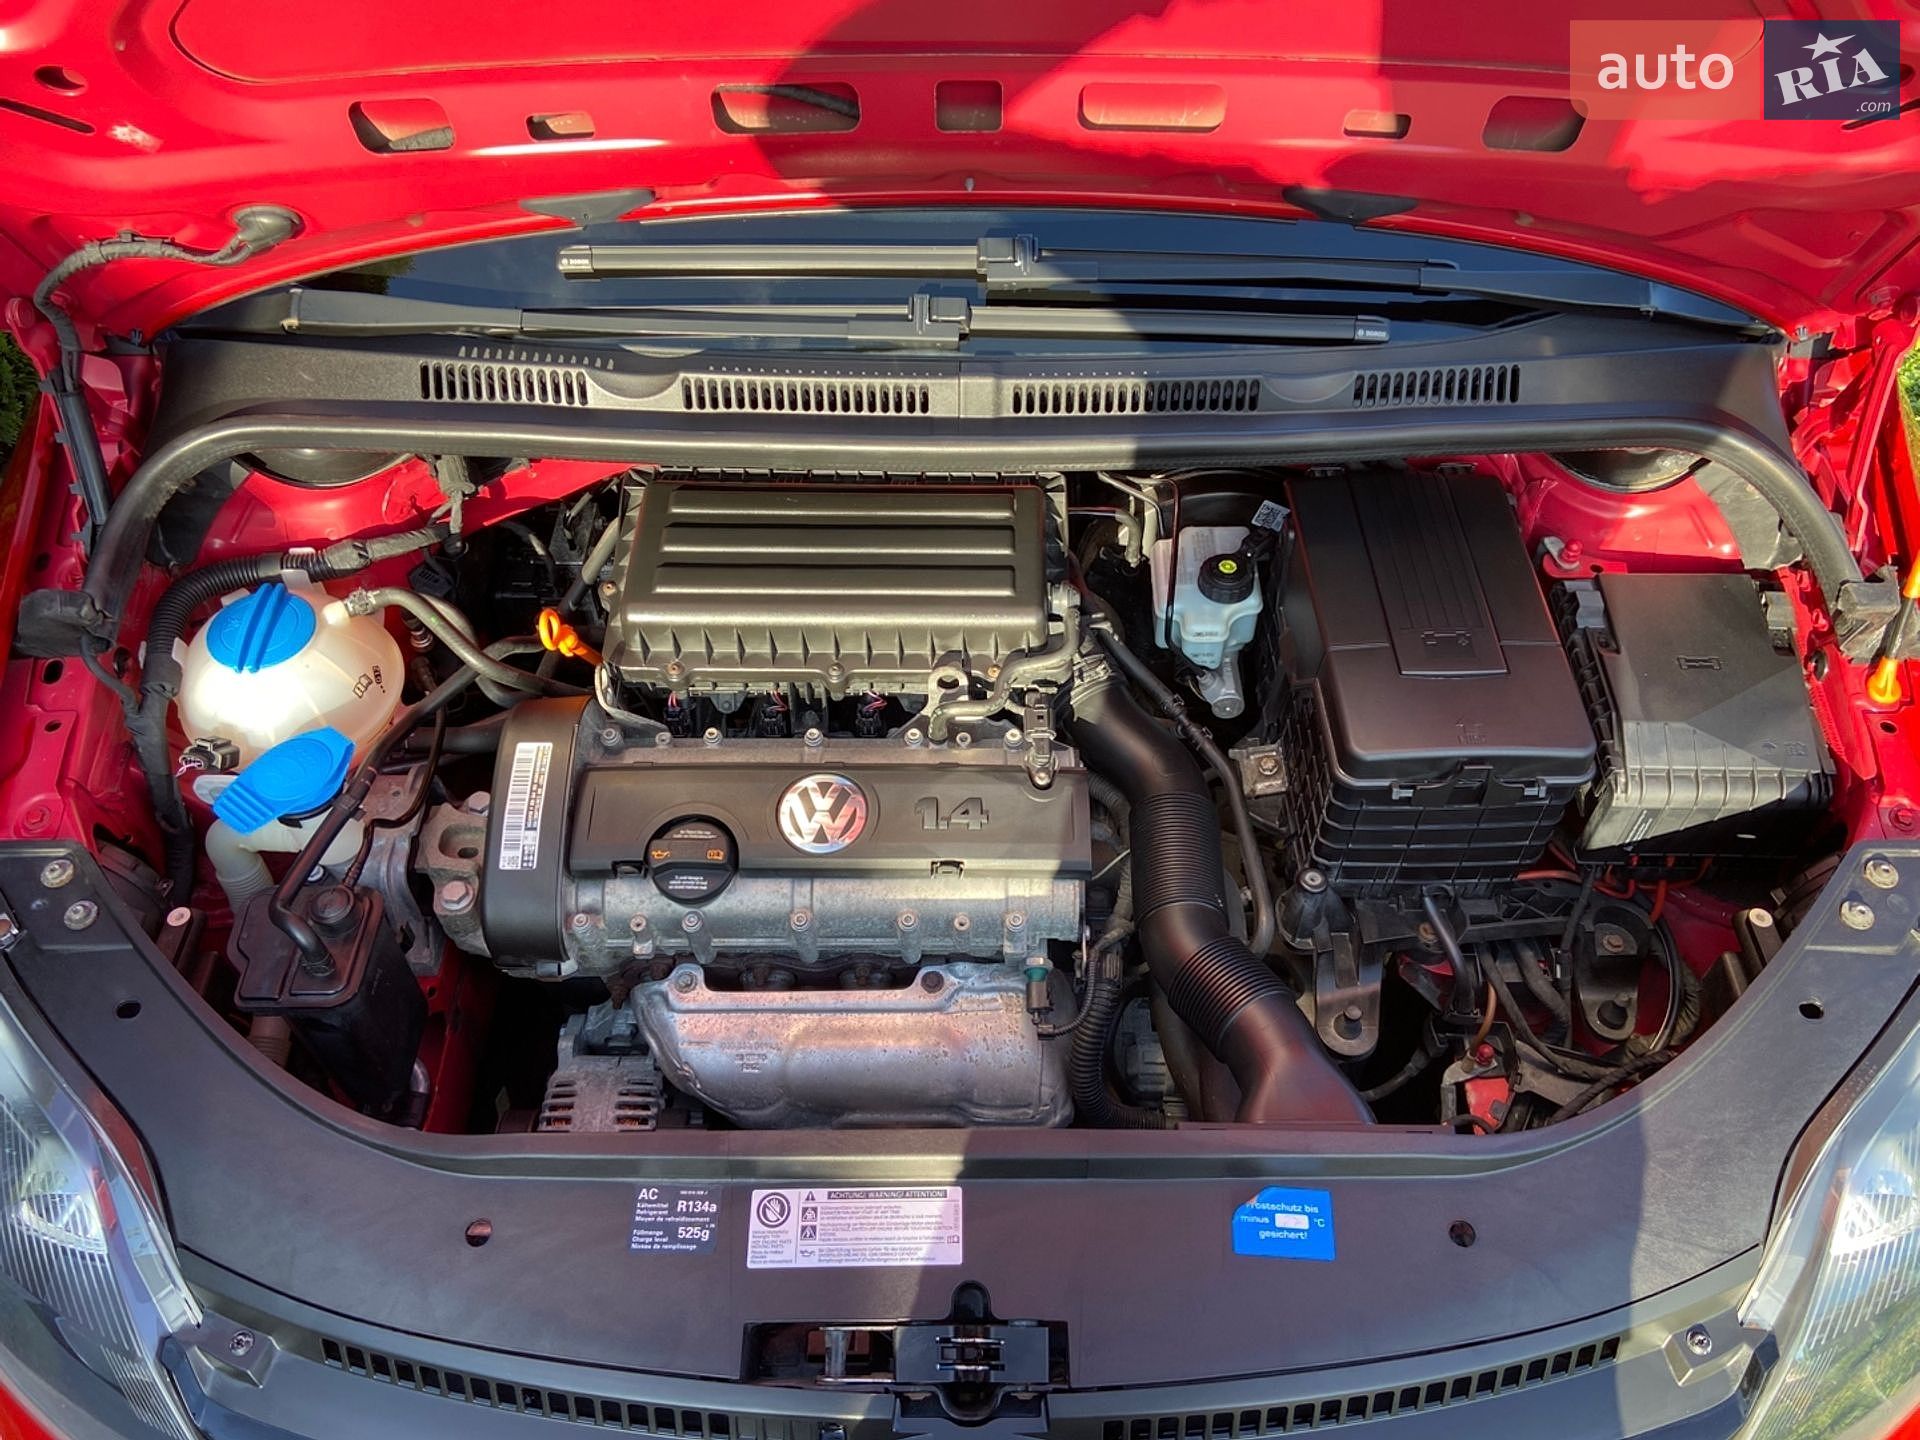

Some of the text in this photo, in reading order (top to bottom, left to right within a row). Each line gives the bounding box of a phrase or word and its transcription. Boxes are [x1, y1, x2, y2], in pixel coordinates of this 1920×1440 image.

[779, 774, 868, 854] VW
[914, 796, 990, 831] 1.4
[638, 1188, 659, 1200] AC
[677, 1200, 717, 1212] R134a
[1304, 1204, 1319, 1213] bis
[678, 1226, 710, 1241] 525g
[1258, 1230, 1308, 1240] gesichert!
